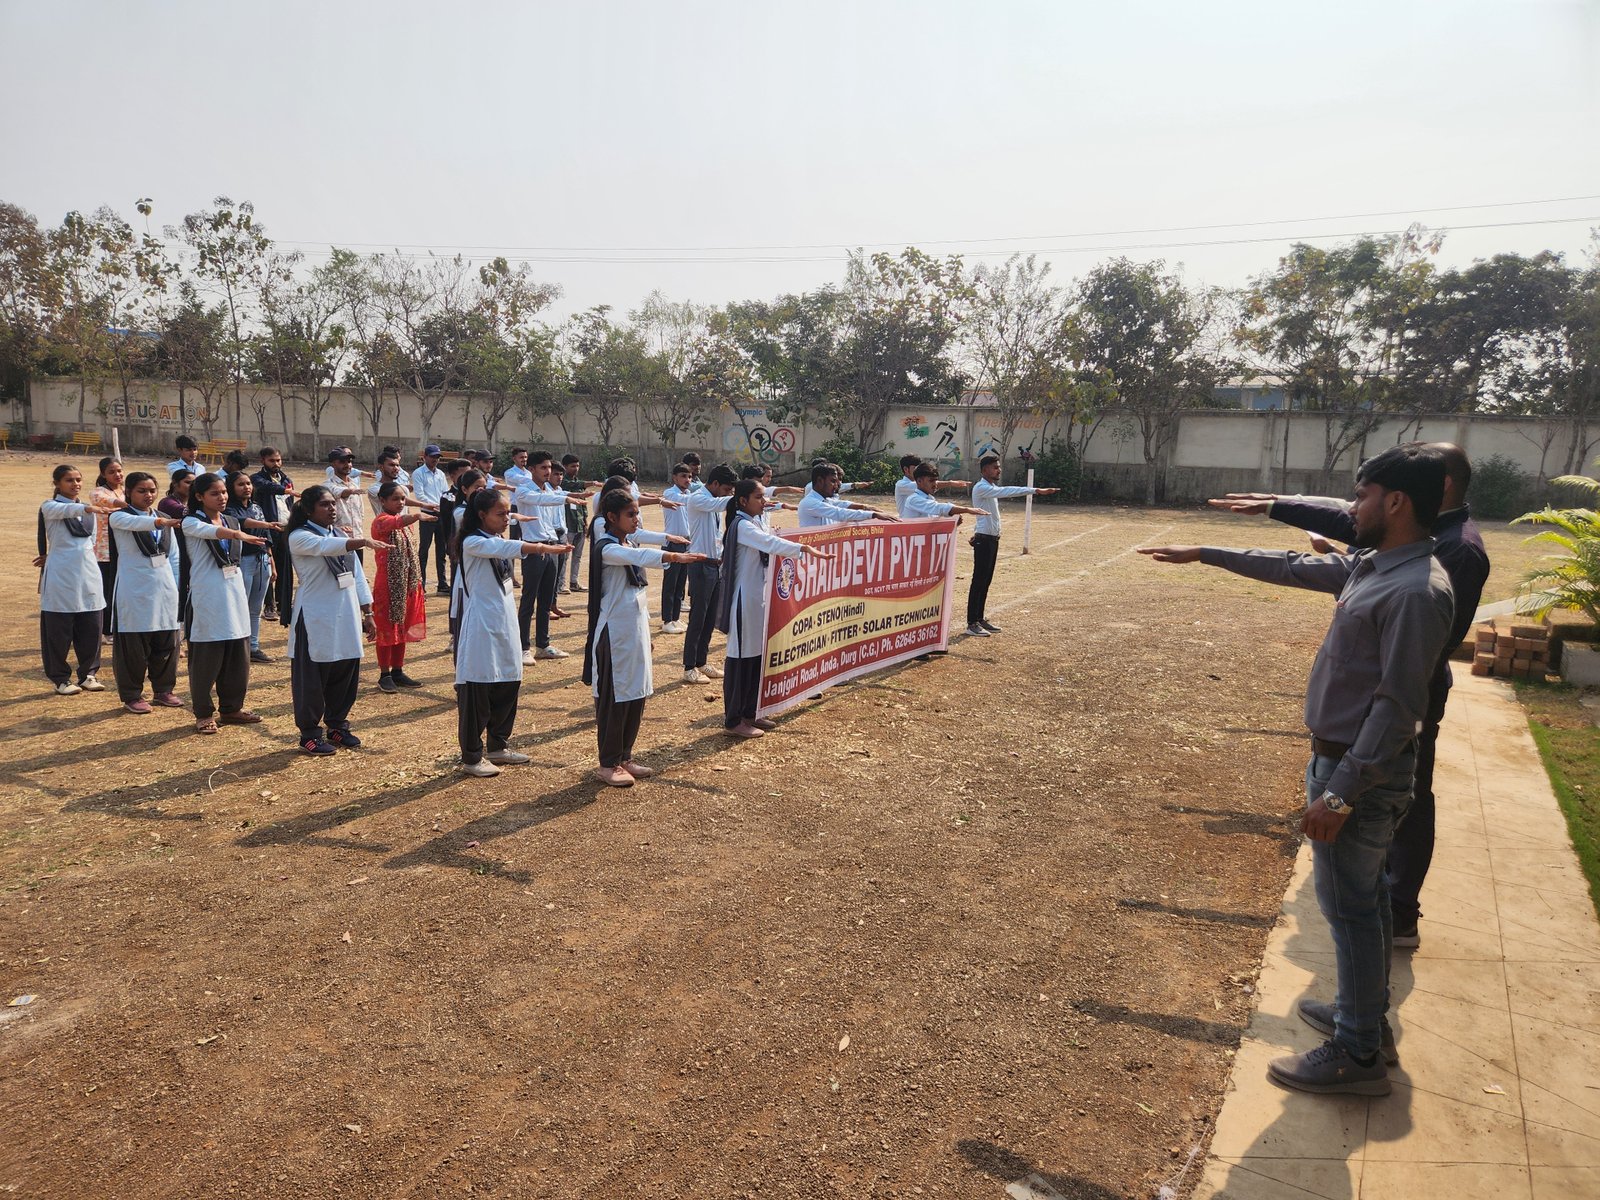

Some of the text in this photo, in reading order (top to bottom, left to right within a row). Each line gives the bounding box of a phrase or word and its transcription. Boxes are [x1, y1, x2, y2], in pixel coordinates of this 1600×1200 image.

[113, 404, 207, 420] EDUCATON
[975, 415, 1010, 429] Khel
[852, 527, 870, 537] Society,
[794, 537, 885, 602] SHAILDEVI
[889, 534, 926, 580] PVT
[769, 605, 940, 668] ELECTRICIAN FITTER SOLAR TECHNICIAN
[792, 602, 865, 637] COPA STENO(Hindi)
[764, 671, 799, 698] Janjgiri
[800, 662, 819, 685] Road,
[820, 656, 839, 675] Anda,
[840, 650, 858, 666] Durg
[859, 641, 880, 662] (C.G.)
[881, 637, 894, 653] Ph.
[895, 630, 916, 650] 62645
